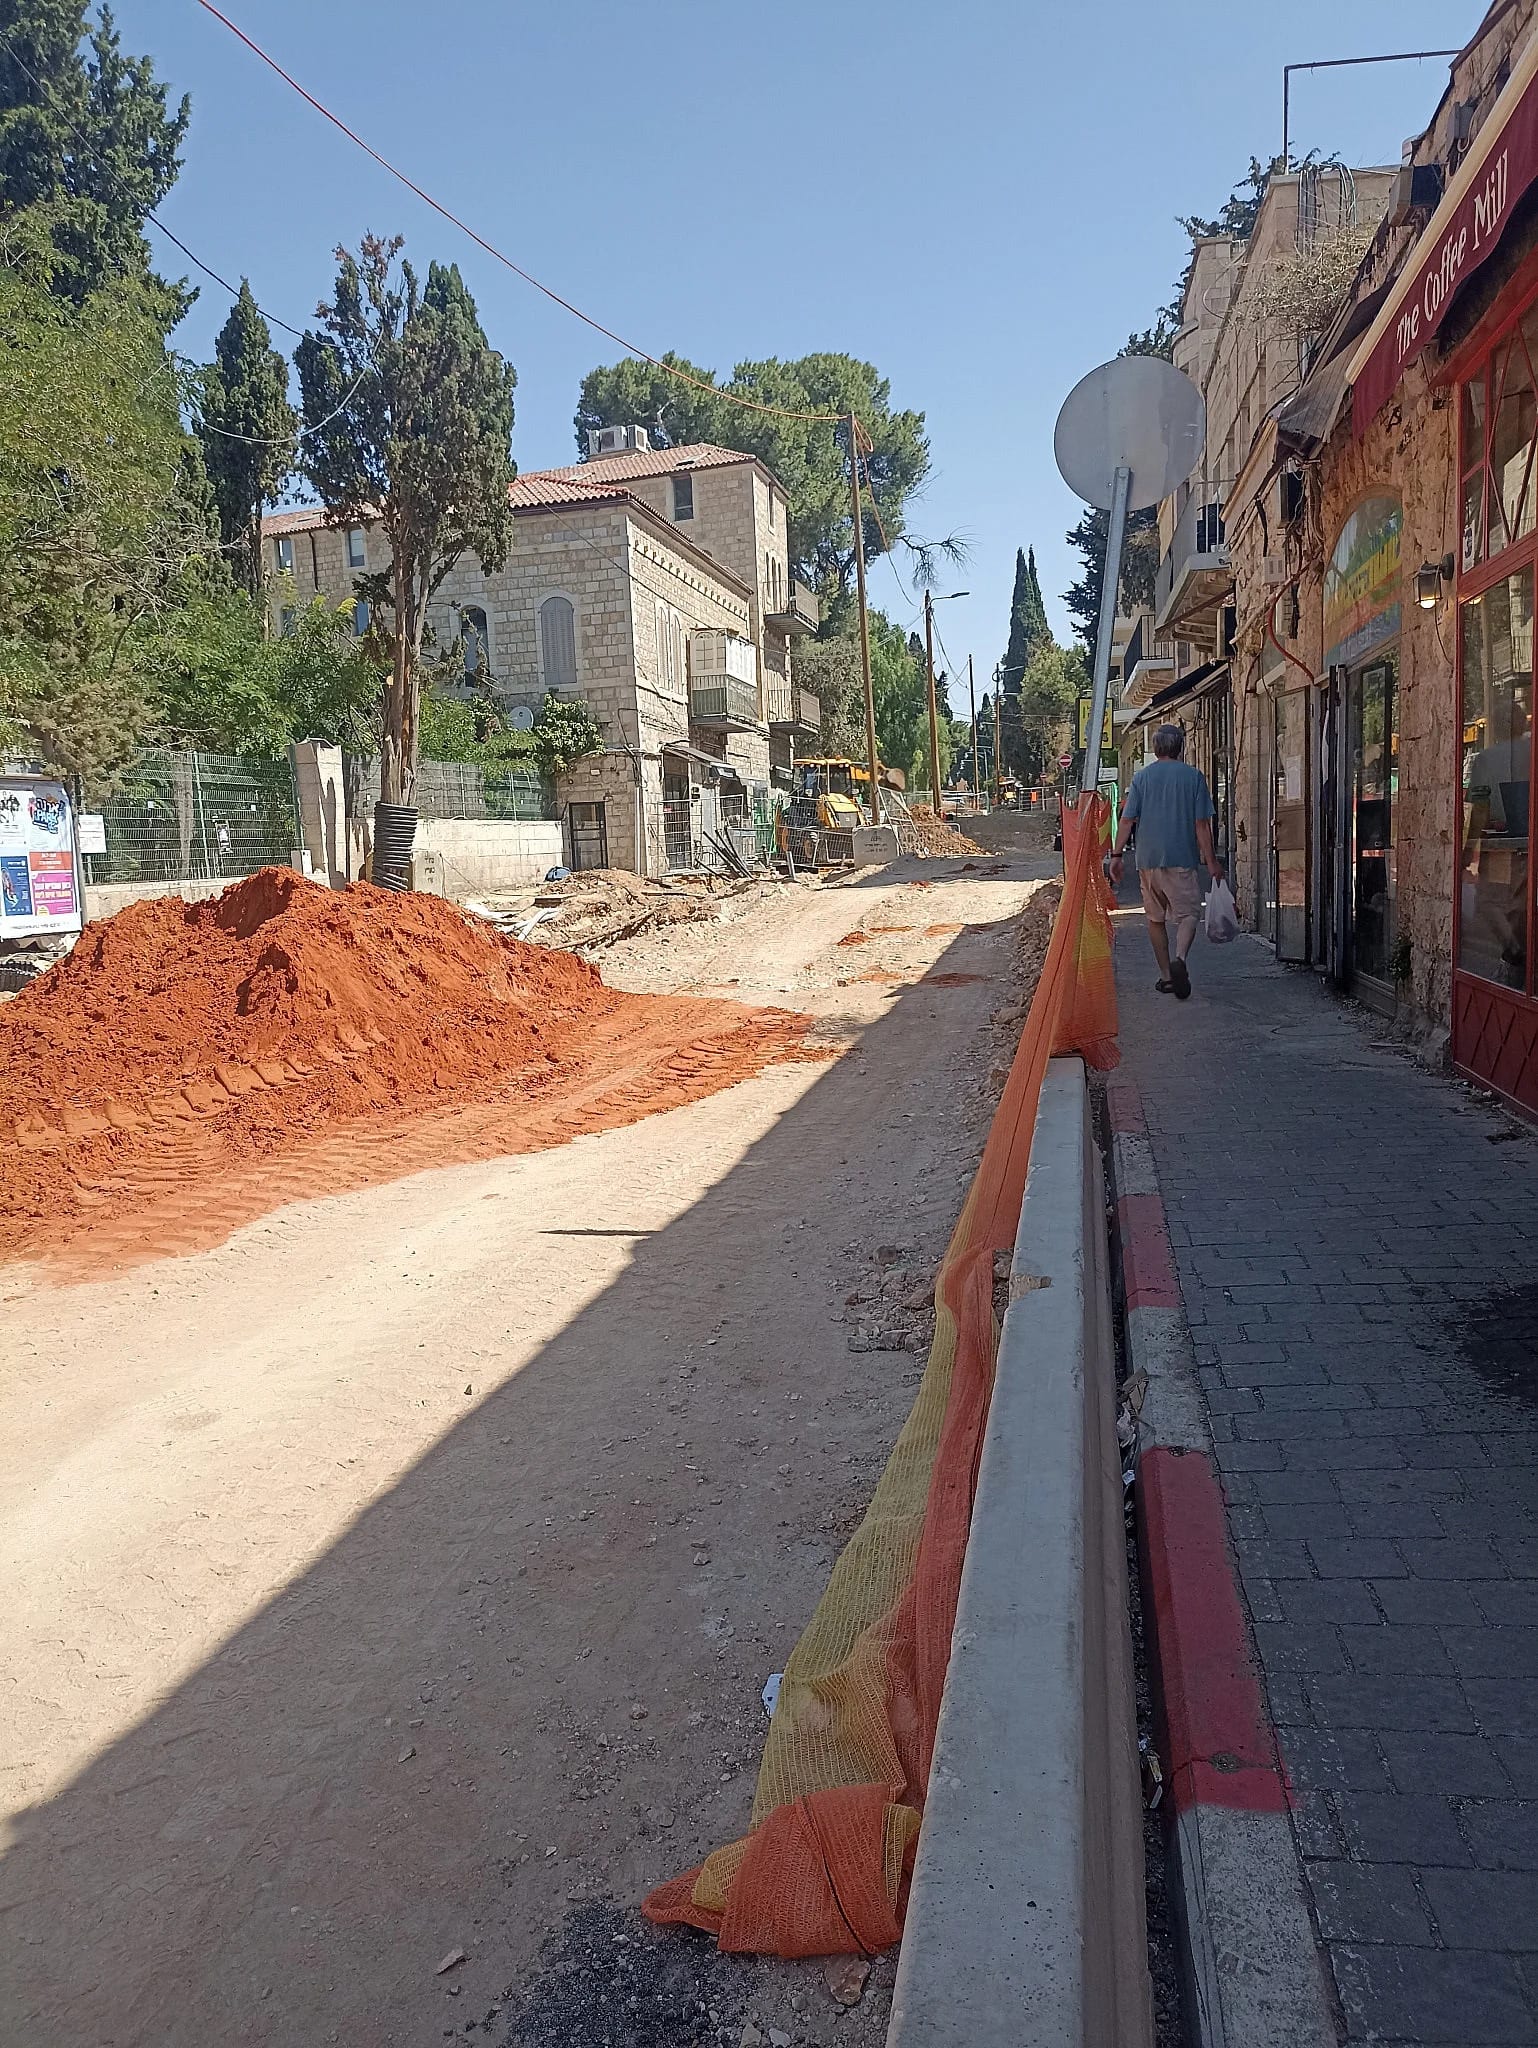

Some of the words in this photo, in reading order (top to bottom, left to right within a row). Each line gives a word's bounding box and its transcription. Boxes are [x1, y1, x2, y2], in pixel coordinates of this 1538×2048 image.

[1397, 303, 1420, 363] The
[1424, 226, 1467, 322] Coffee
[1472, 148, 1508, 251] Mill
